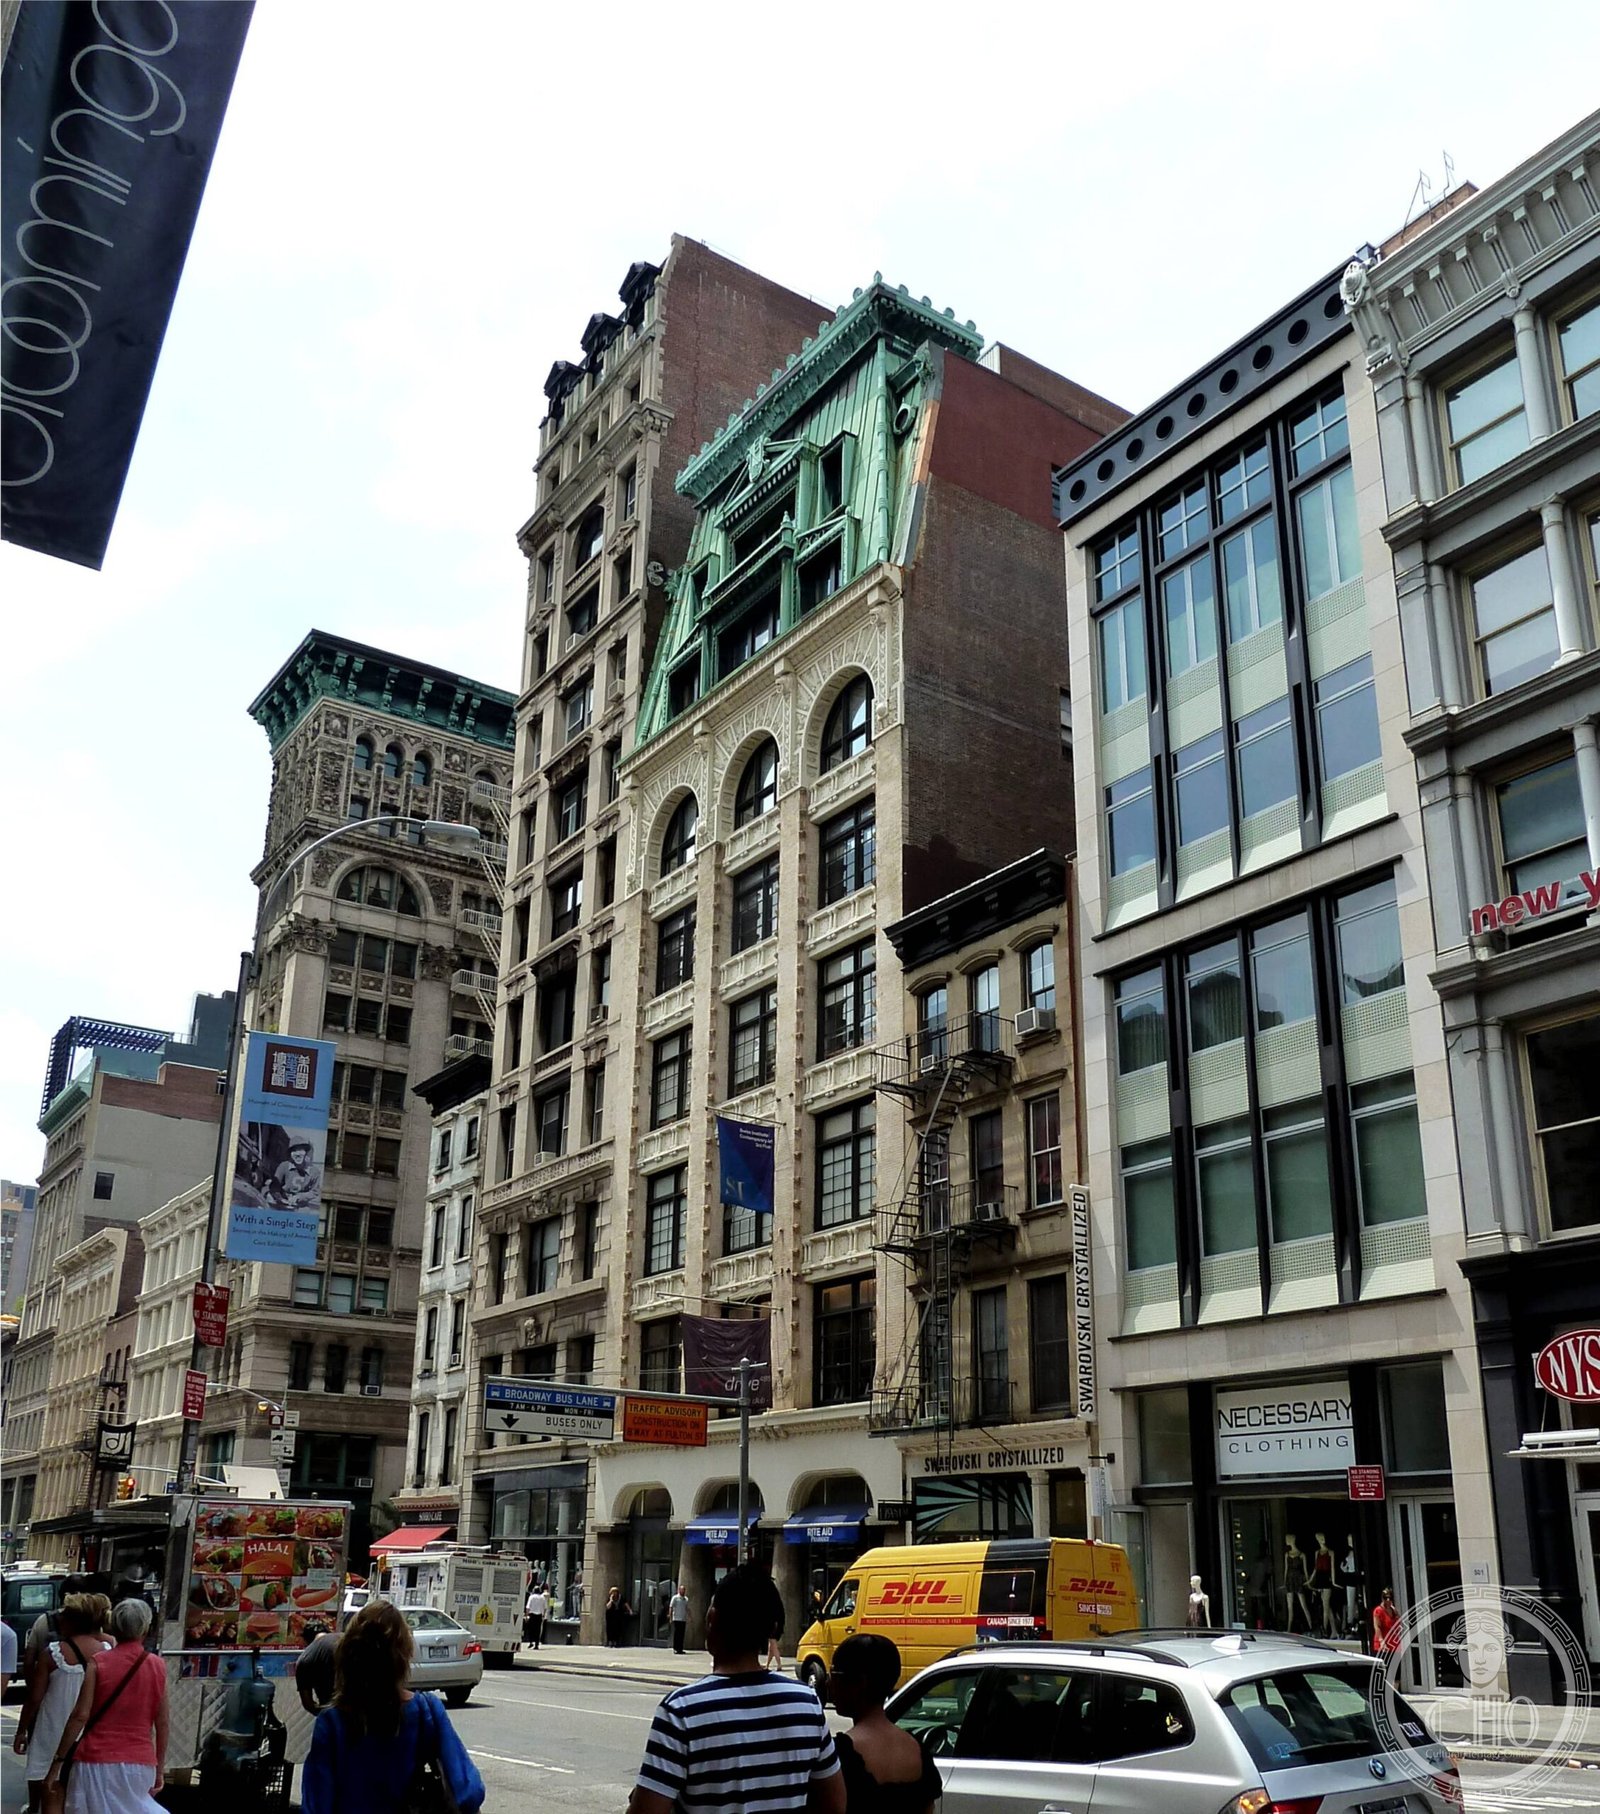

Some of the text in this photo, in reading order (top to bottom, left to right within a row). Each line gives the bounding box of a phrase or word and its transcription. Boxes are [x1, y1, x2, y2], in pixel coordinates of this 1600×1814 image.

[1469, 880, 1561, 936] new
[234, 1213, 257, 1224] With
[266, 1216, 294, 1230] Single
[296, 1219, 316, 1232] Step
[1073, 1192, 1094, 1413] SWAROVSKI CRYSTALLIZED
[202, 1311, 226, 1323] STANDING
[1546, 1335, 1600, 1395] NYS
[504, 1388, 599, 1406] BROADWAY BUS LANE
[629, 1403, 702, 1418] TRAFFIC ADVISORY
[1218, 1399, 1352, 1429] NECESSARY
[546, 1416, 603, 1430] BUSES ONLY
[632, 1416, 700, 1429] CONSTRUCTION ON
[654, 1430, 663, 1438] AT
[666, 1430, 693, 1440] FULTON
[695, 1432, 704, 1441] ST
[1229, 1435, 1349, 1454] CLOTHING
[924, 1446, 1064, 1473] SWAROVSKI CRYSTALLIZED
[705, 1530, 728, 1539] RITE AID
[807, 1527, 833, 1536] RITE AID
[247, 1541, 291, 1556] HALAL
[880, 1580, 950, 1605] DHL
[1069, 1577, 1118, 1596] DHL
[1078, 1604, 1096, 1614] SINCE
[986, 1617, 1008, 1626] CANADA
